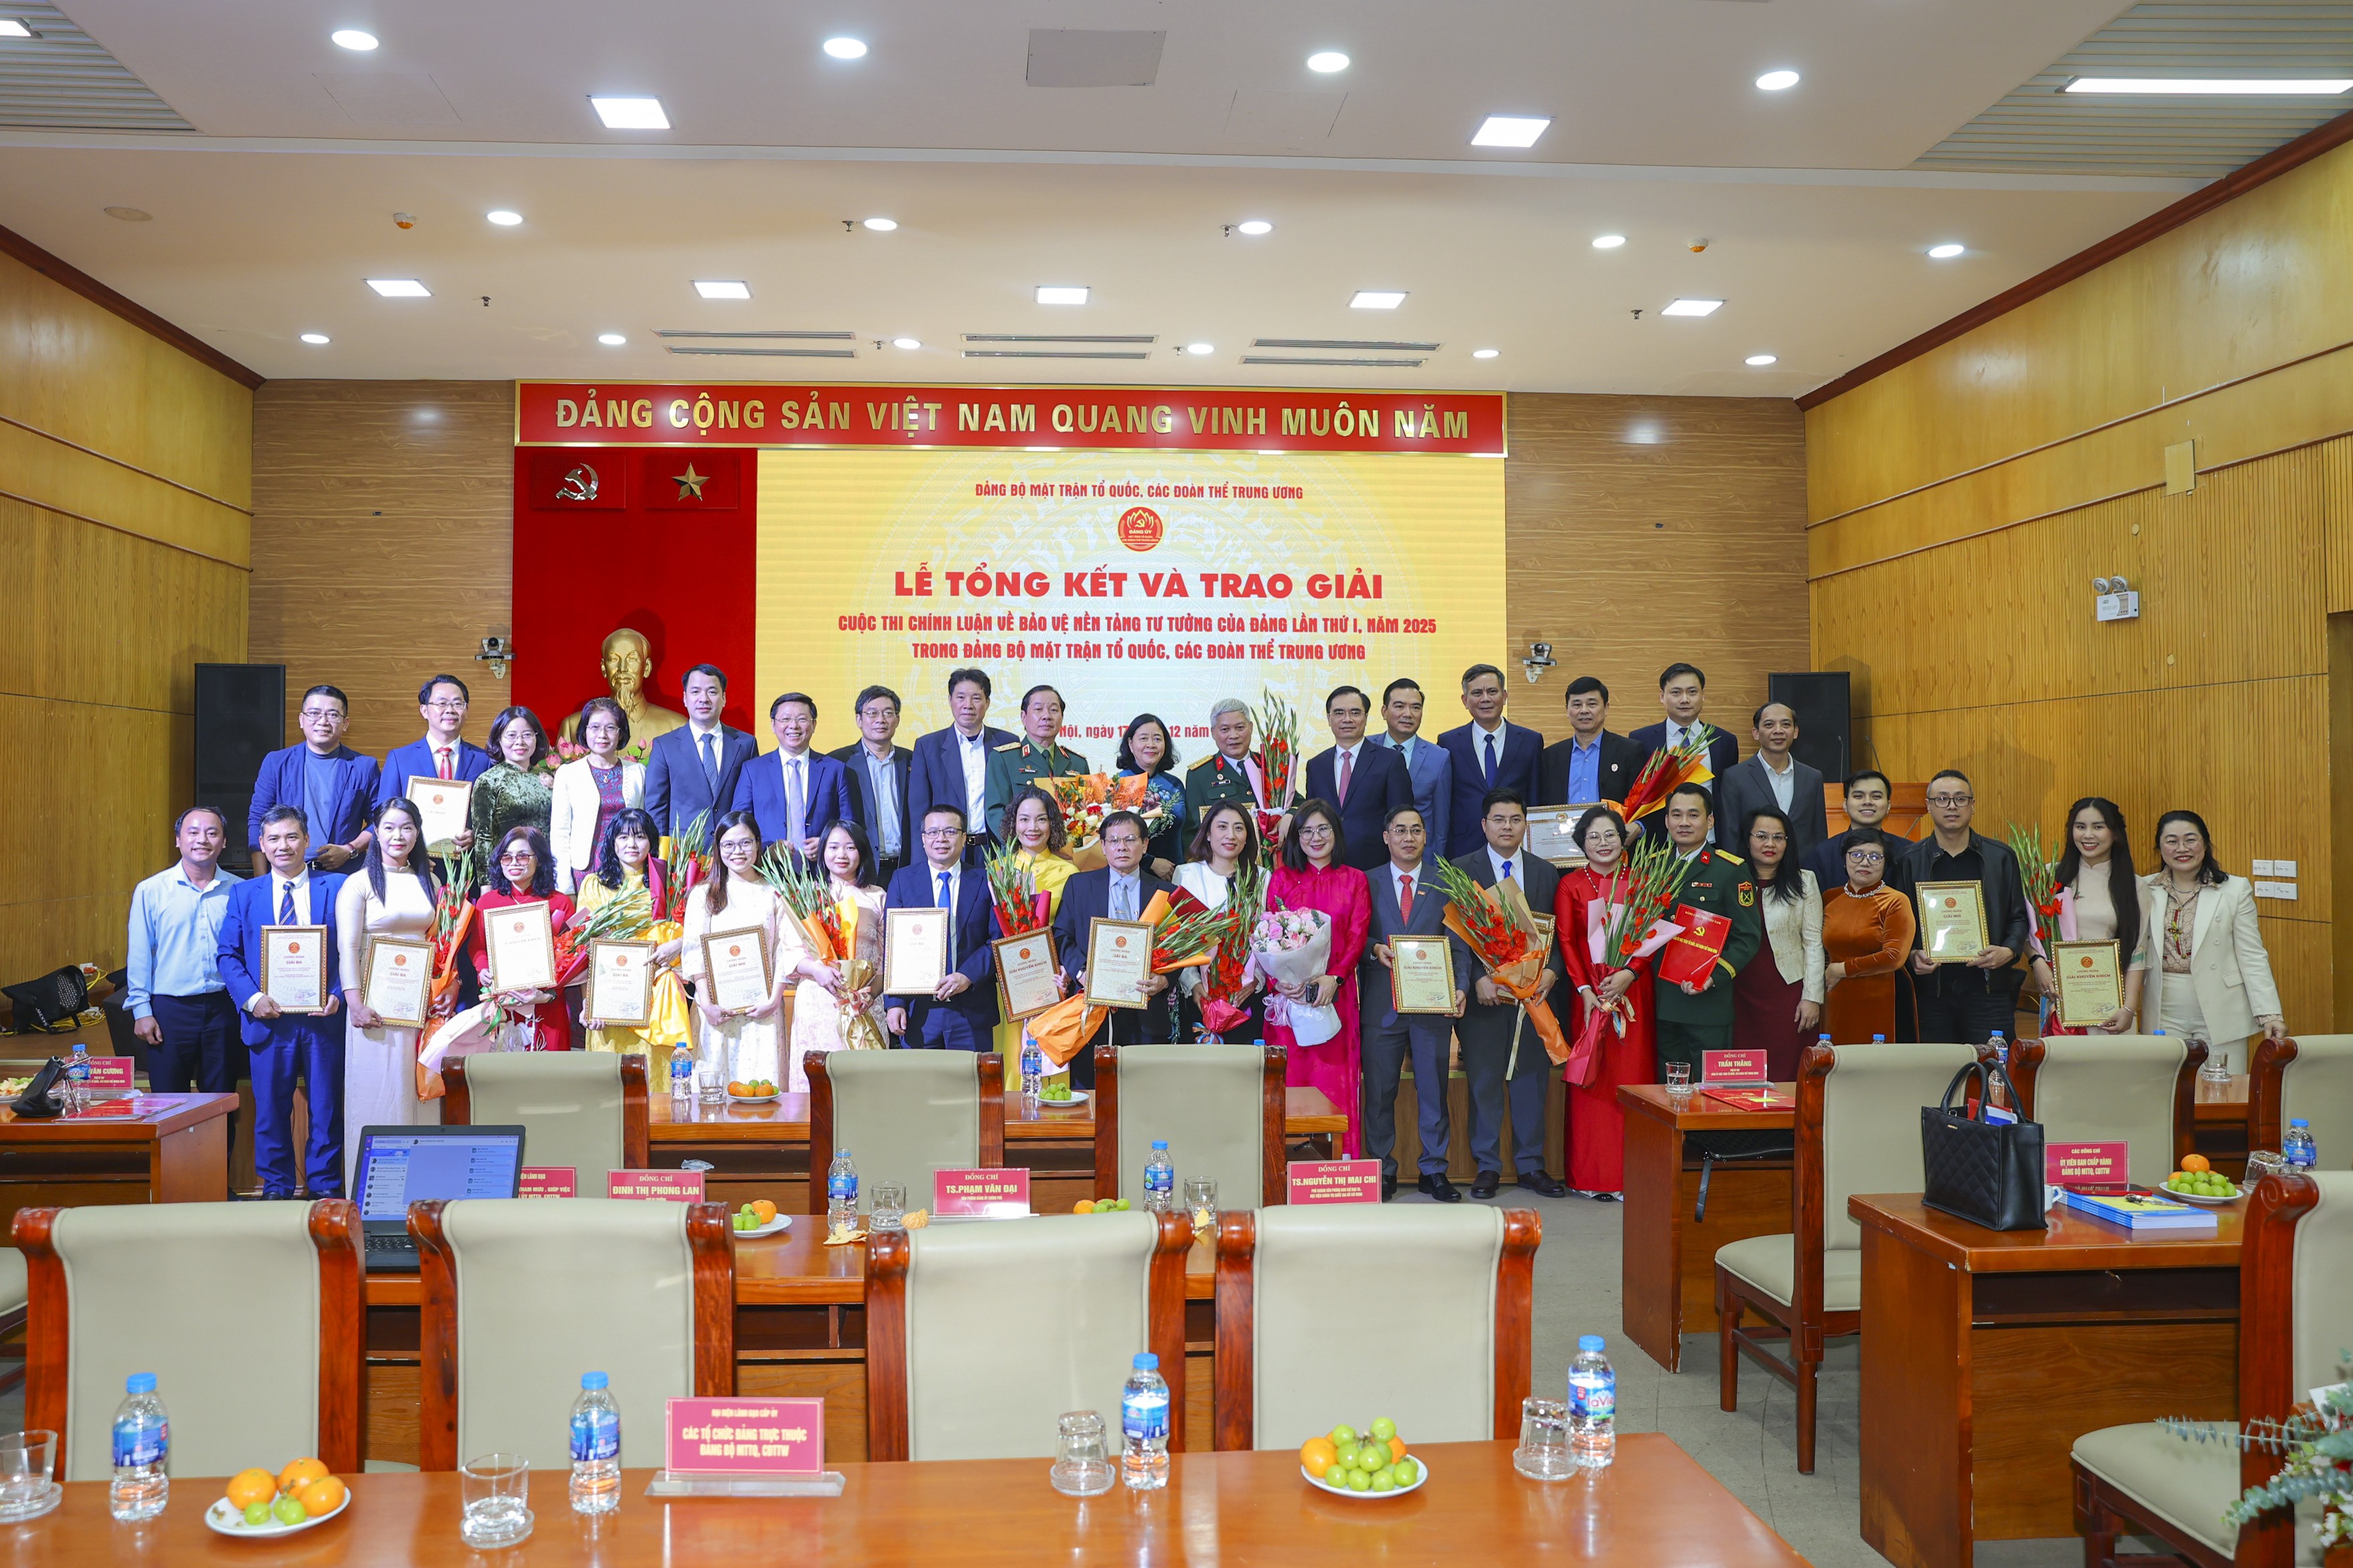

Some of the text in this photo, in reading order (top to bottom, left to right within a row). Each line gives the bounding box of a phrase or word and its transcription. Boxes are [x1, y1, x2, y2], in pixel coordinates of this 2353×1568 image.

[556, 388, 1468, 439] ĐẢNG CỘNG SẢN VIỆT NAM QUANG VINH MUÔN NĂM
[976, 480, 1303, 499] ĐẢNG BỘ MẶT TRẬN TỔ QUỐC, CÁC ĐOÀN THỂ TRUNG ƯƠNG
[895, 562, 1382, 599] LỄ TỔNG KẾT VÀ TRAO GIẢI
[839, 611, 1436, 634] CUỘC THI CHÍNH LUẬN VỀ BẢO VỆ NỀN TẢNG TƯ TƯỞNG CỦA ĐẢNG LẦN THỨ I, NĂM 2025
[912, 637, 1365, 662] TRONG ĐẢNG BỘ MẶT TRẬN TỔ QUỐC, CÁC ĐOÀN THỂ TRUNG ƯƠNG
[1086, 724, 1114, 738] ngày
[1185, 724, 1209, 738] năm
[945, 1184, 1018, 1195] TS.PHẠM VĂN ĐẠI
[1334, 1177, 1346, 1186] THỊ
[612, 1186, 700, 1196] ĐINH THỊ PHONG LAN
[1587, 1395, 1615, 1407] laVie
[682, 1425, 699, 1440] CÁC
[712, 1425, 734, 1441] CHỨC
[781, 1426, 807, 1444] THUỘC
